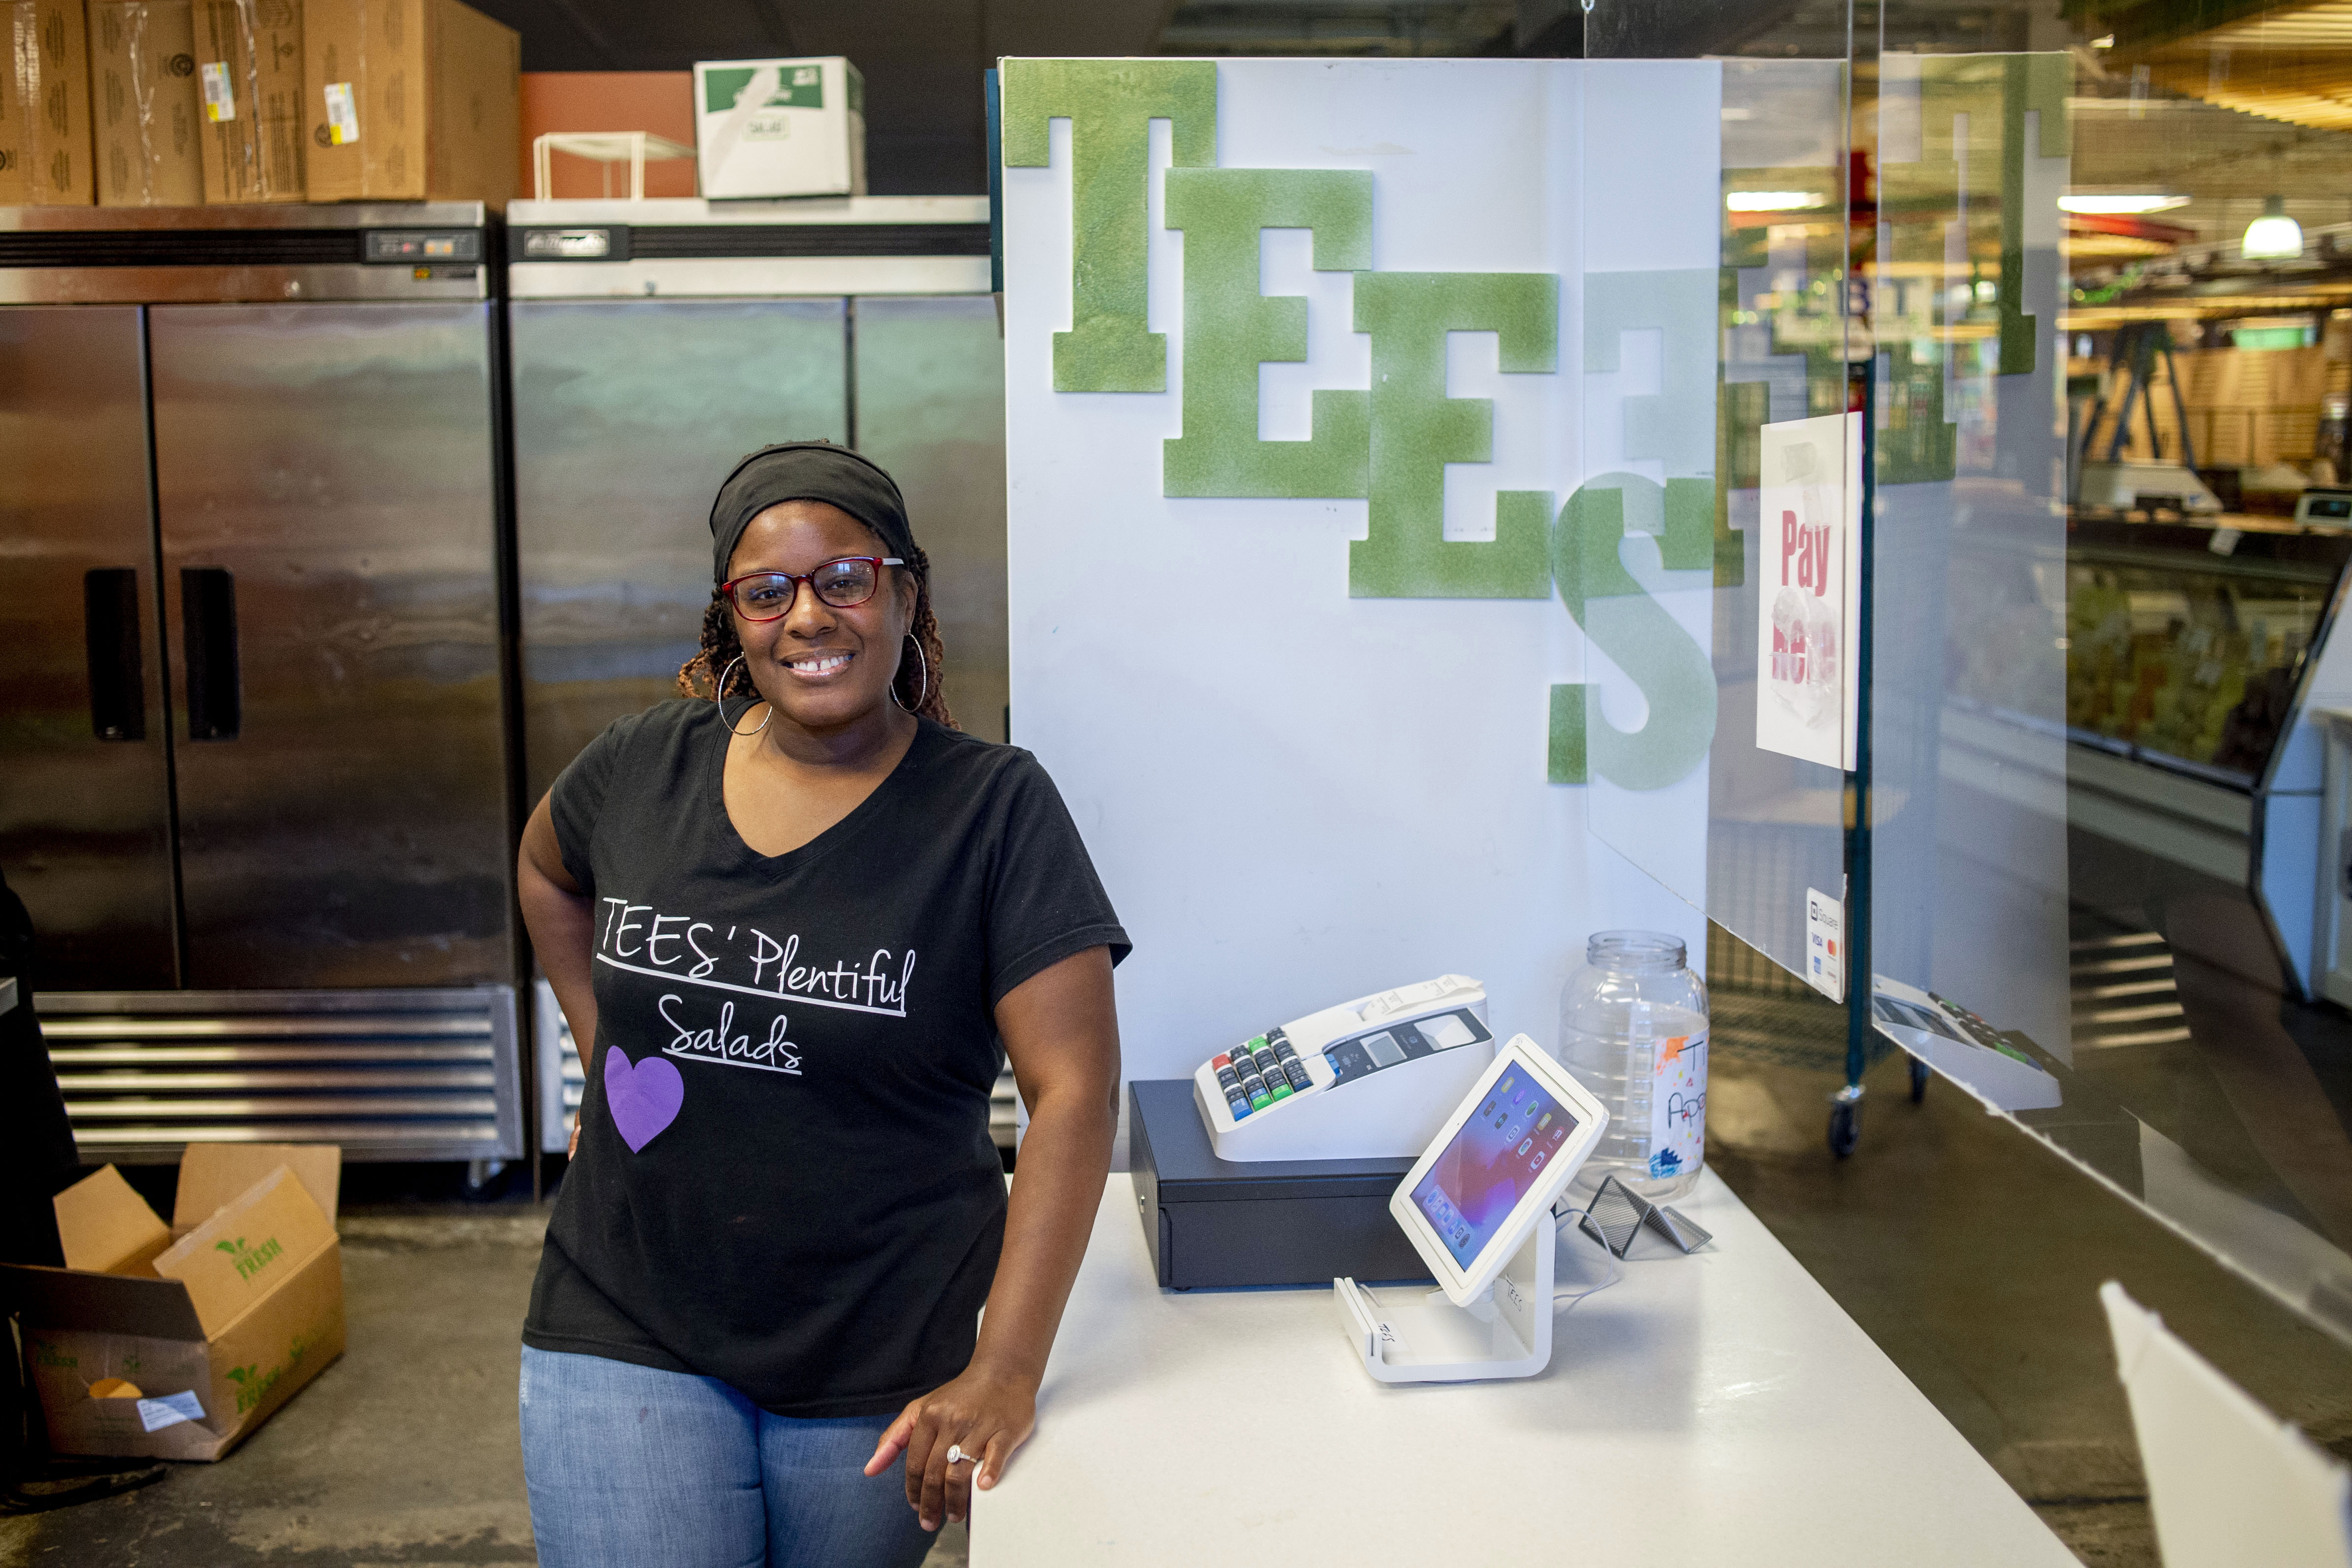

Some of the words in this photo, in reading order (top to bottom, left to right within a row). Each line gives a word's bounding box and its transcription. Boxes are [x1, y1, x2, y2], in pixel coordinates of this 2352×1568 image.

[1004, 60, 1717, 792] TEES
[1781, 510, 1830, 597] Pay
[1811, 932, 1823, 947] VISA
[1819, 909, 1838, 930] Square
[749, 928, 916, 1013] Plentiful
[658, 993, 803, 1070] Salads
[1505, 1278, 1523, 1312] TEES
